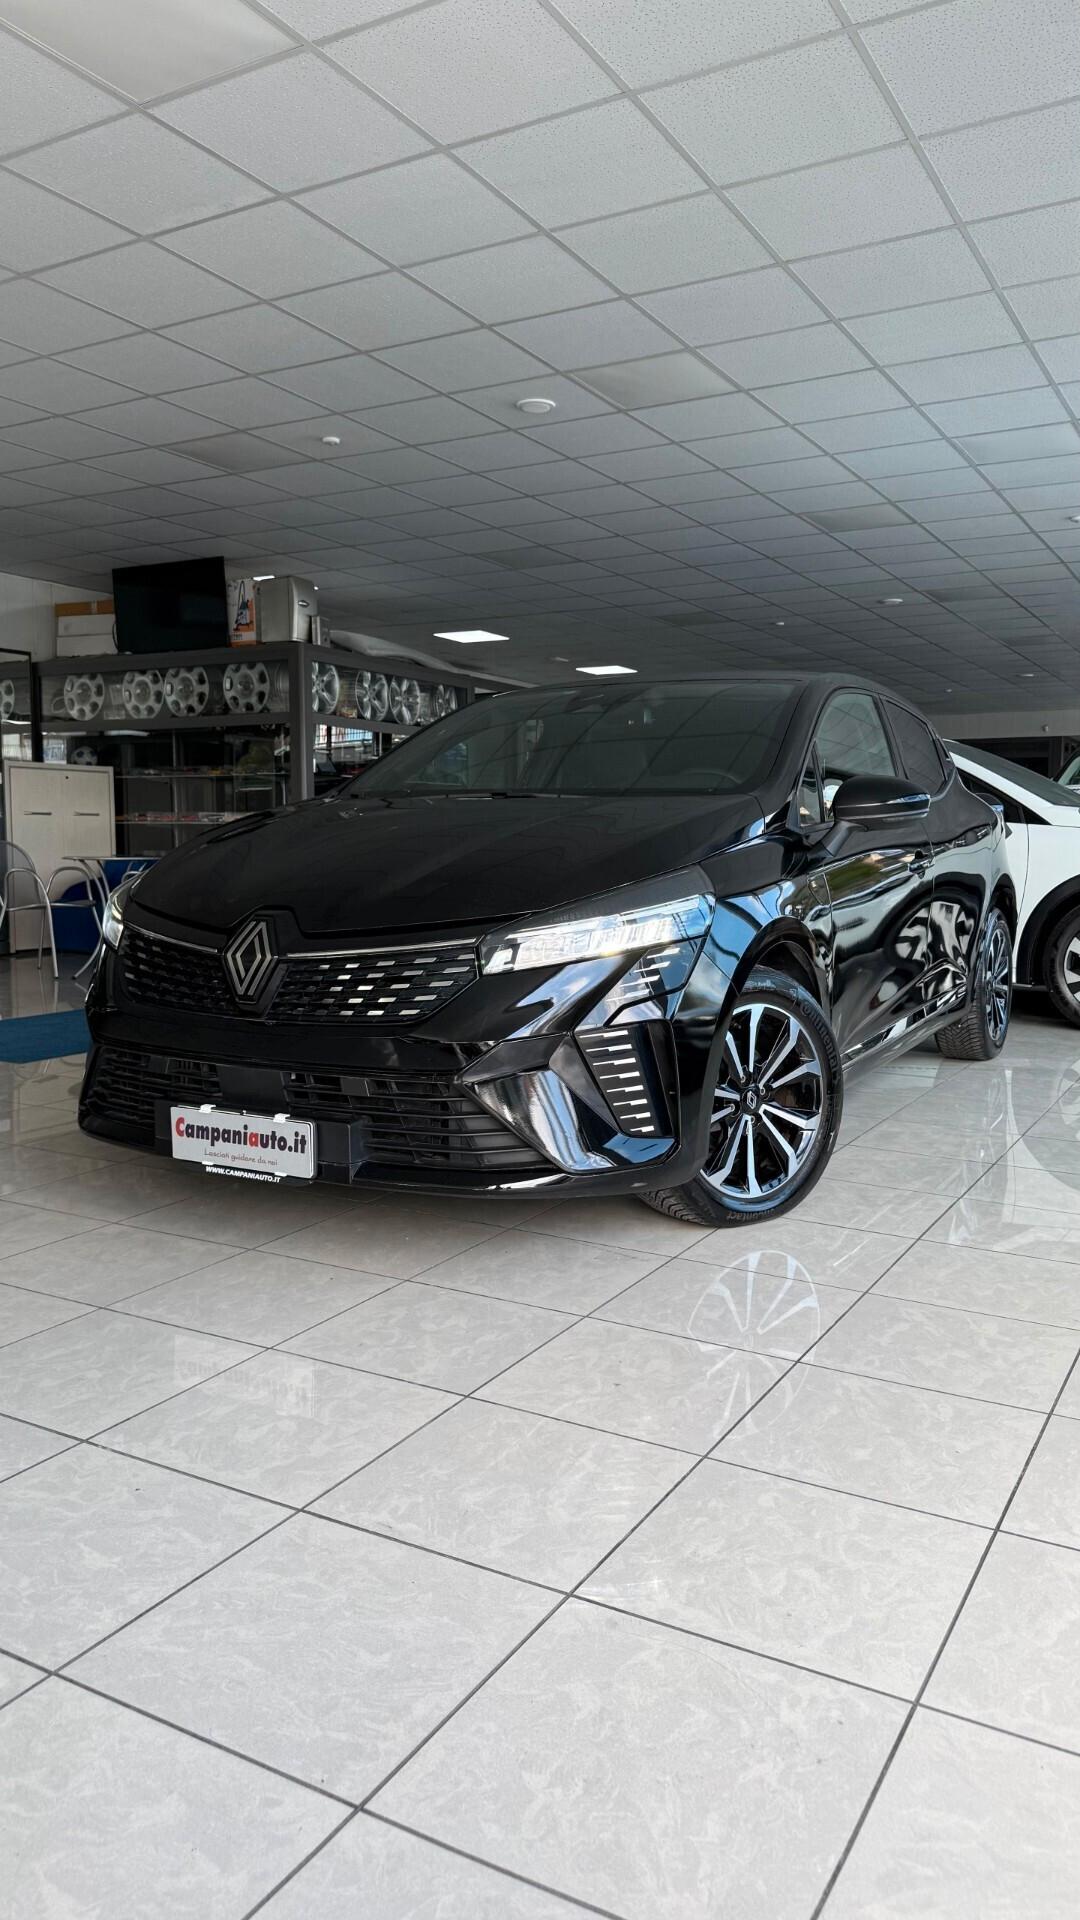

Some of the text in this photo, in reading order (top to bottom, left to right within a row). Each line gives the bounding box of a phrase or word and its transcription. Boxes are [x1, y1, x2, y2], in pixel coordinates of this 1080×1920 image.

[175, 1117, 307, 1153] Campaniauto.it
[203, 1147, 230, 1159] Lasciati
[231, 1153, 256, 1162] guidare
[257, 1155, 266, 1164] da
[205, 1165, 281, 1183] WWW.CAMPANIAUTO.IT
